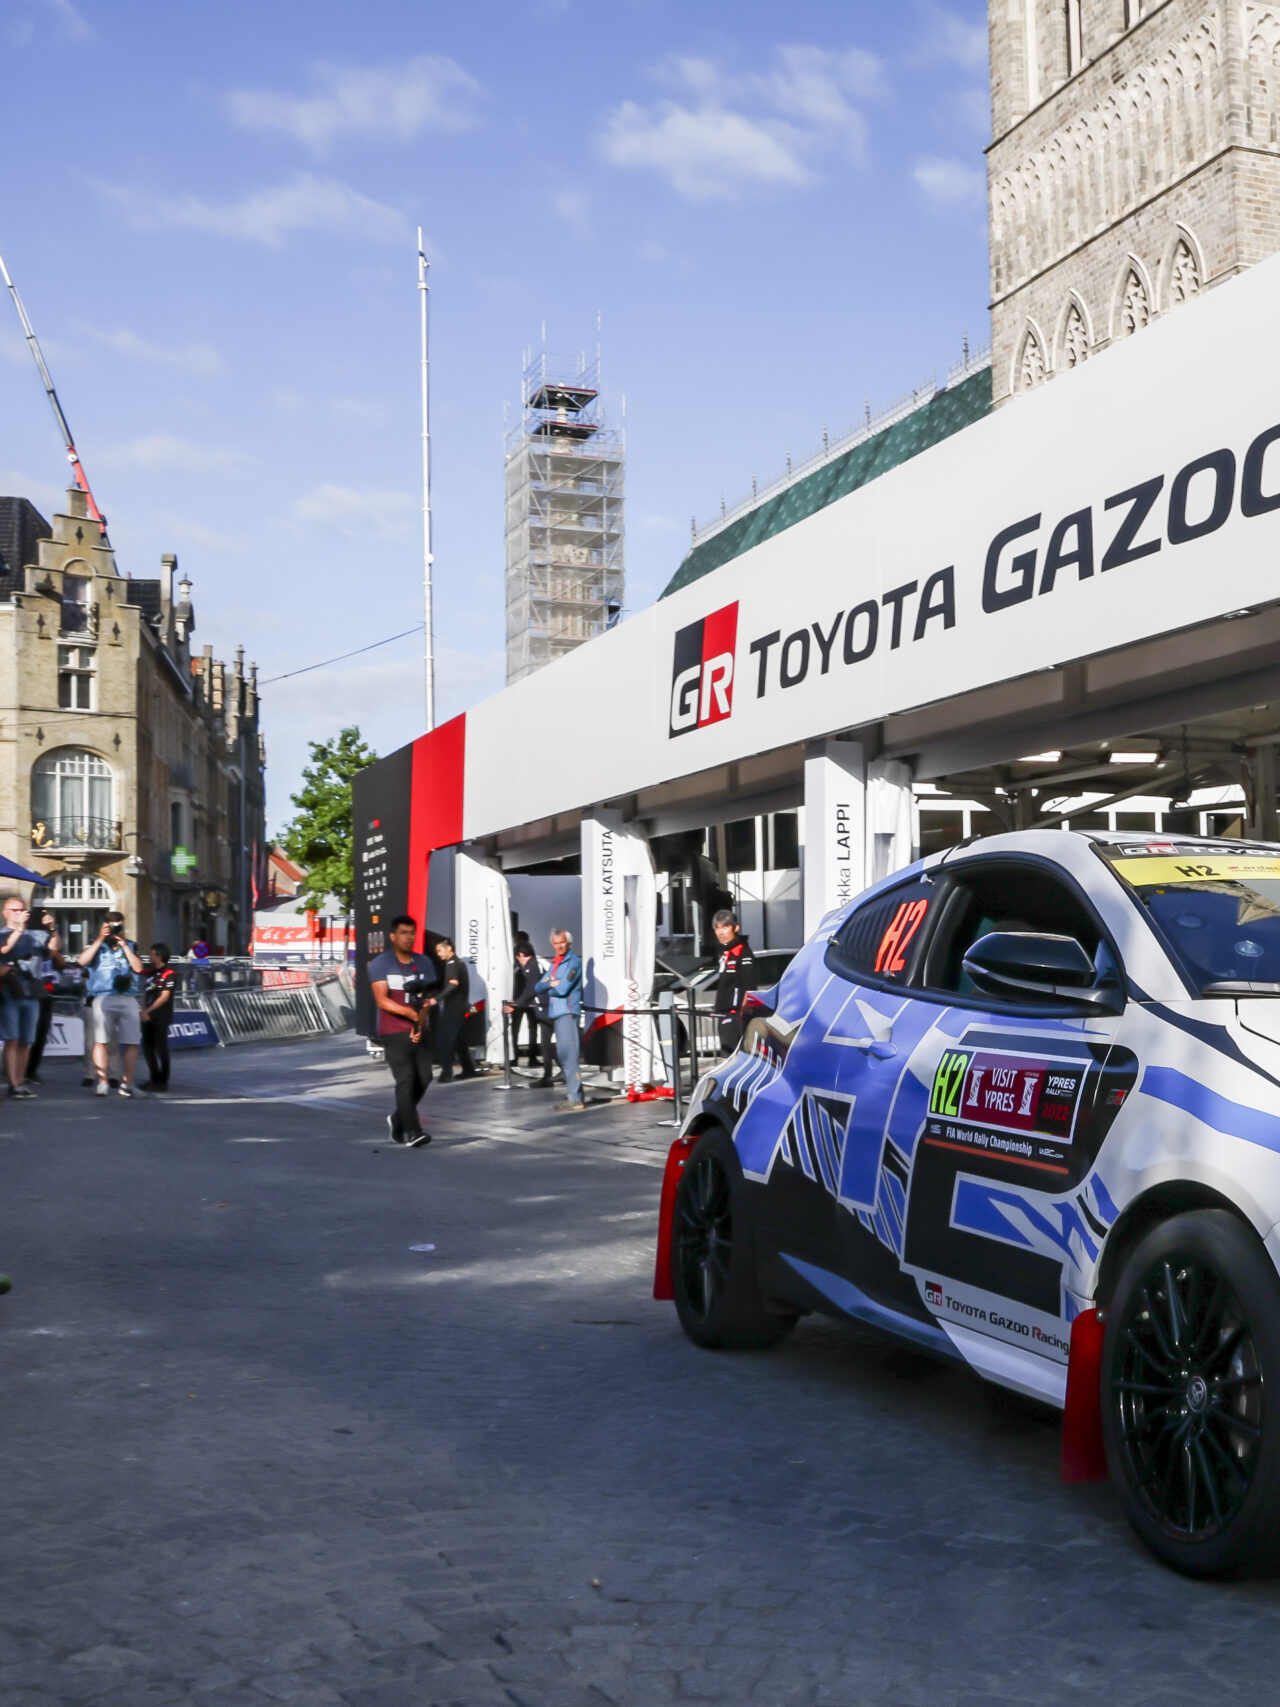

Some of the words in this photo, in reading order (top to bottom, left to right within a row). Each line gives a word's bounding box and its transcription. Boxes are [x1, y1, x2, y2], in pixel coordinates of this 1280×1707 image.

[671, 651, 734, 732] GR
[749, 565, 956, 699] TOYOTA
[837, 804, 851, 861] LAPPI
[602, 830, 614, 895] KATSUTA
[1174, 865, 1221, 878] H2
[469, 919, 479, 965] MORIZO
[603, 899, 615, 961] Takamoto
[874, 898, 929, 973] H2
[930, 1052, 968, 1117] H2
[984, 1089, 1016, 1113] YPRES
[991, 1067, 1018, 1089] VISIT
[1045, 1087, 1061, 1096] RALLY
[1047, 1075, 1076, 1090] YPRES
[1041, 1102, 1071, 1121] 2022
[946, 1126, 956, 1138] FIA
[956, 1128, 973, 1142] World
[974, 1132, 990, 1148] Rally
[990, 1135, 1033, 1157] Championship
[925, 1289, 942, 1306] GR
[945, 1296, 987, 1321] TOYOTA
[989, 1312, 1030, 1337] GAZOO
[1032, 1326, 1069, 1356] Racing
